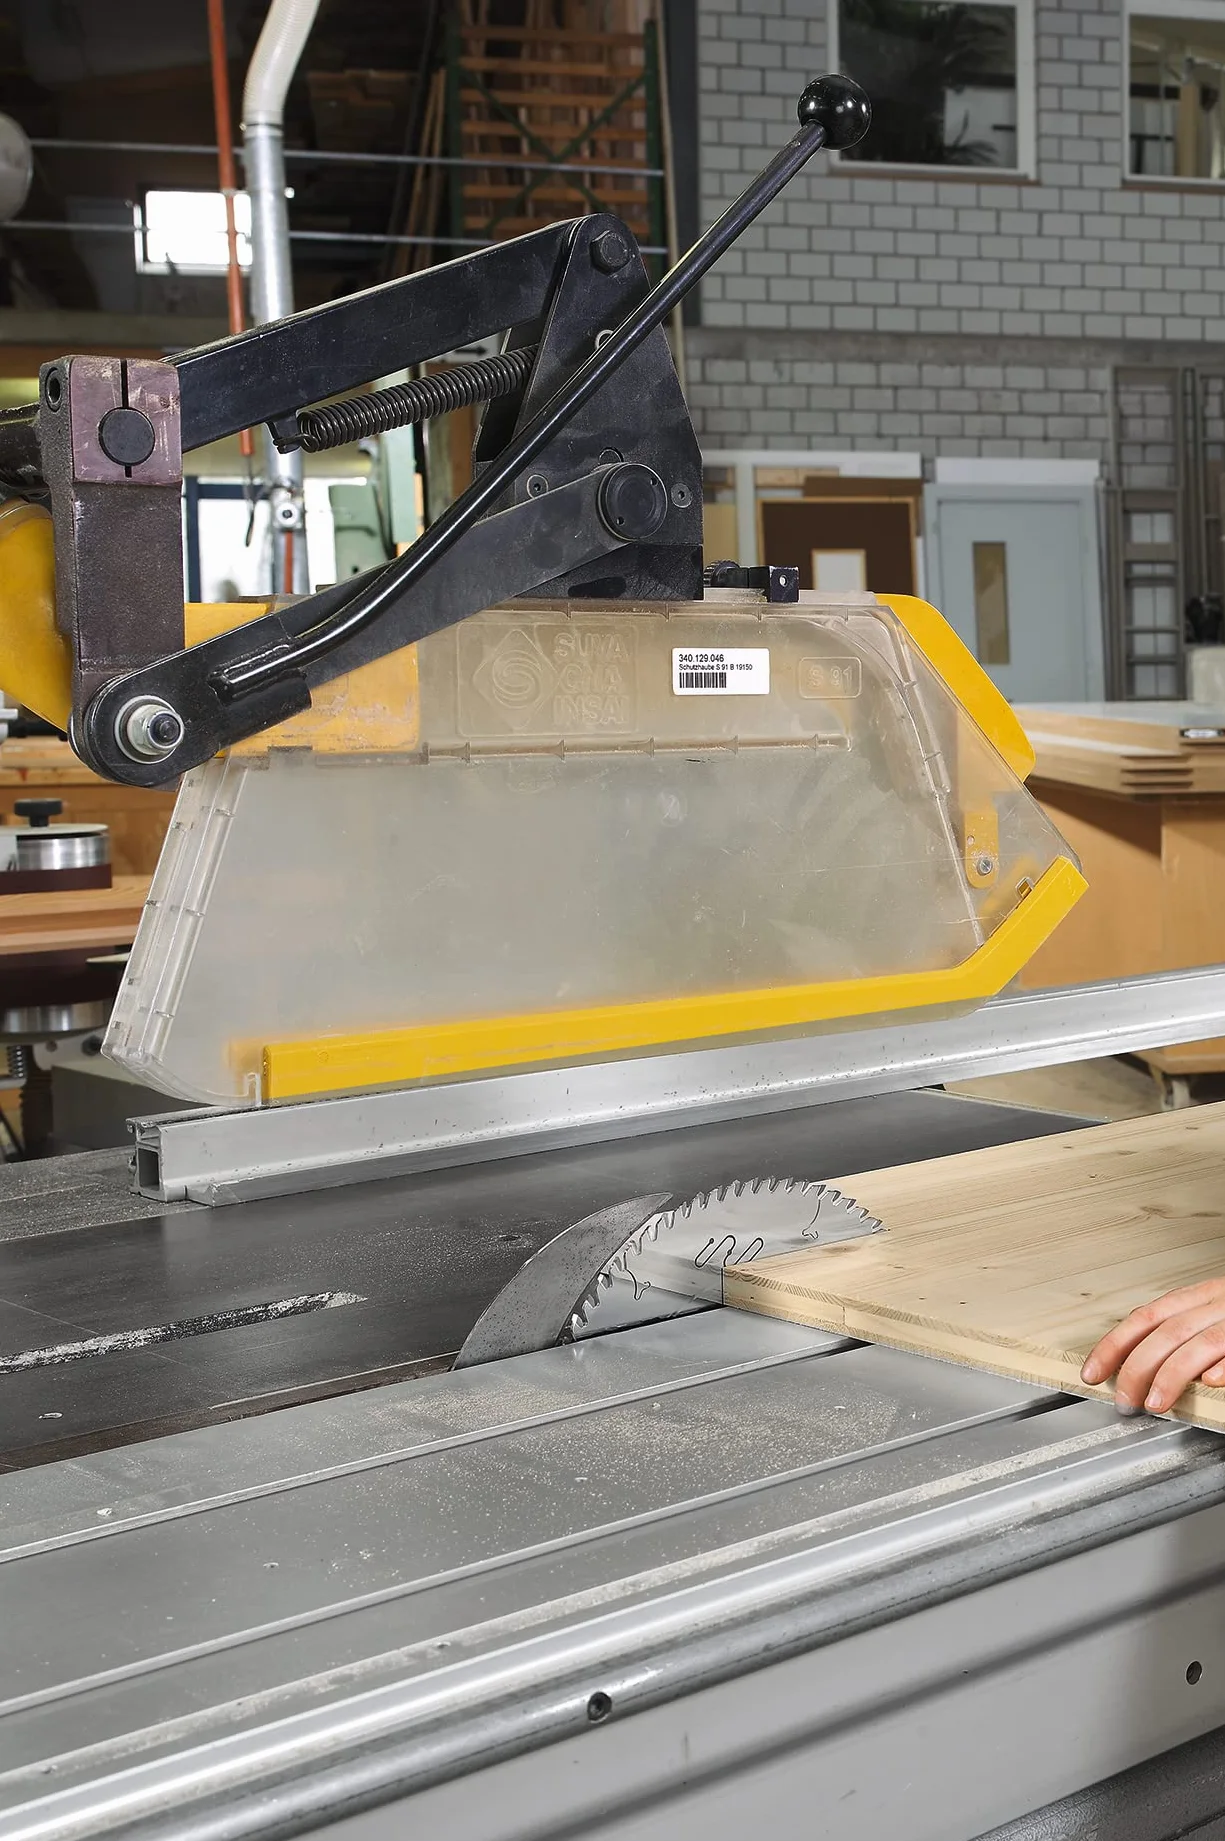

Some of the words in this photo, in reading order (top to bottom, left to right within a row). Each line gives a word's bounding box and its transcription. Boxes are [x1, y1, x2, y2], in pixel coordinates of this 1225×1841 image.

[554, 632, 628, 661] SUVA
[678, 653, 725, 663] 340.129.046
[807, 664, 824, 689] S
[830, 665, 853, 690] 91
